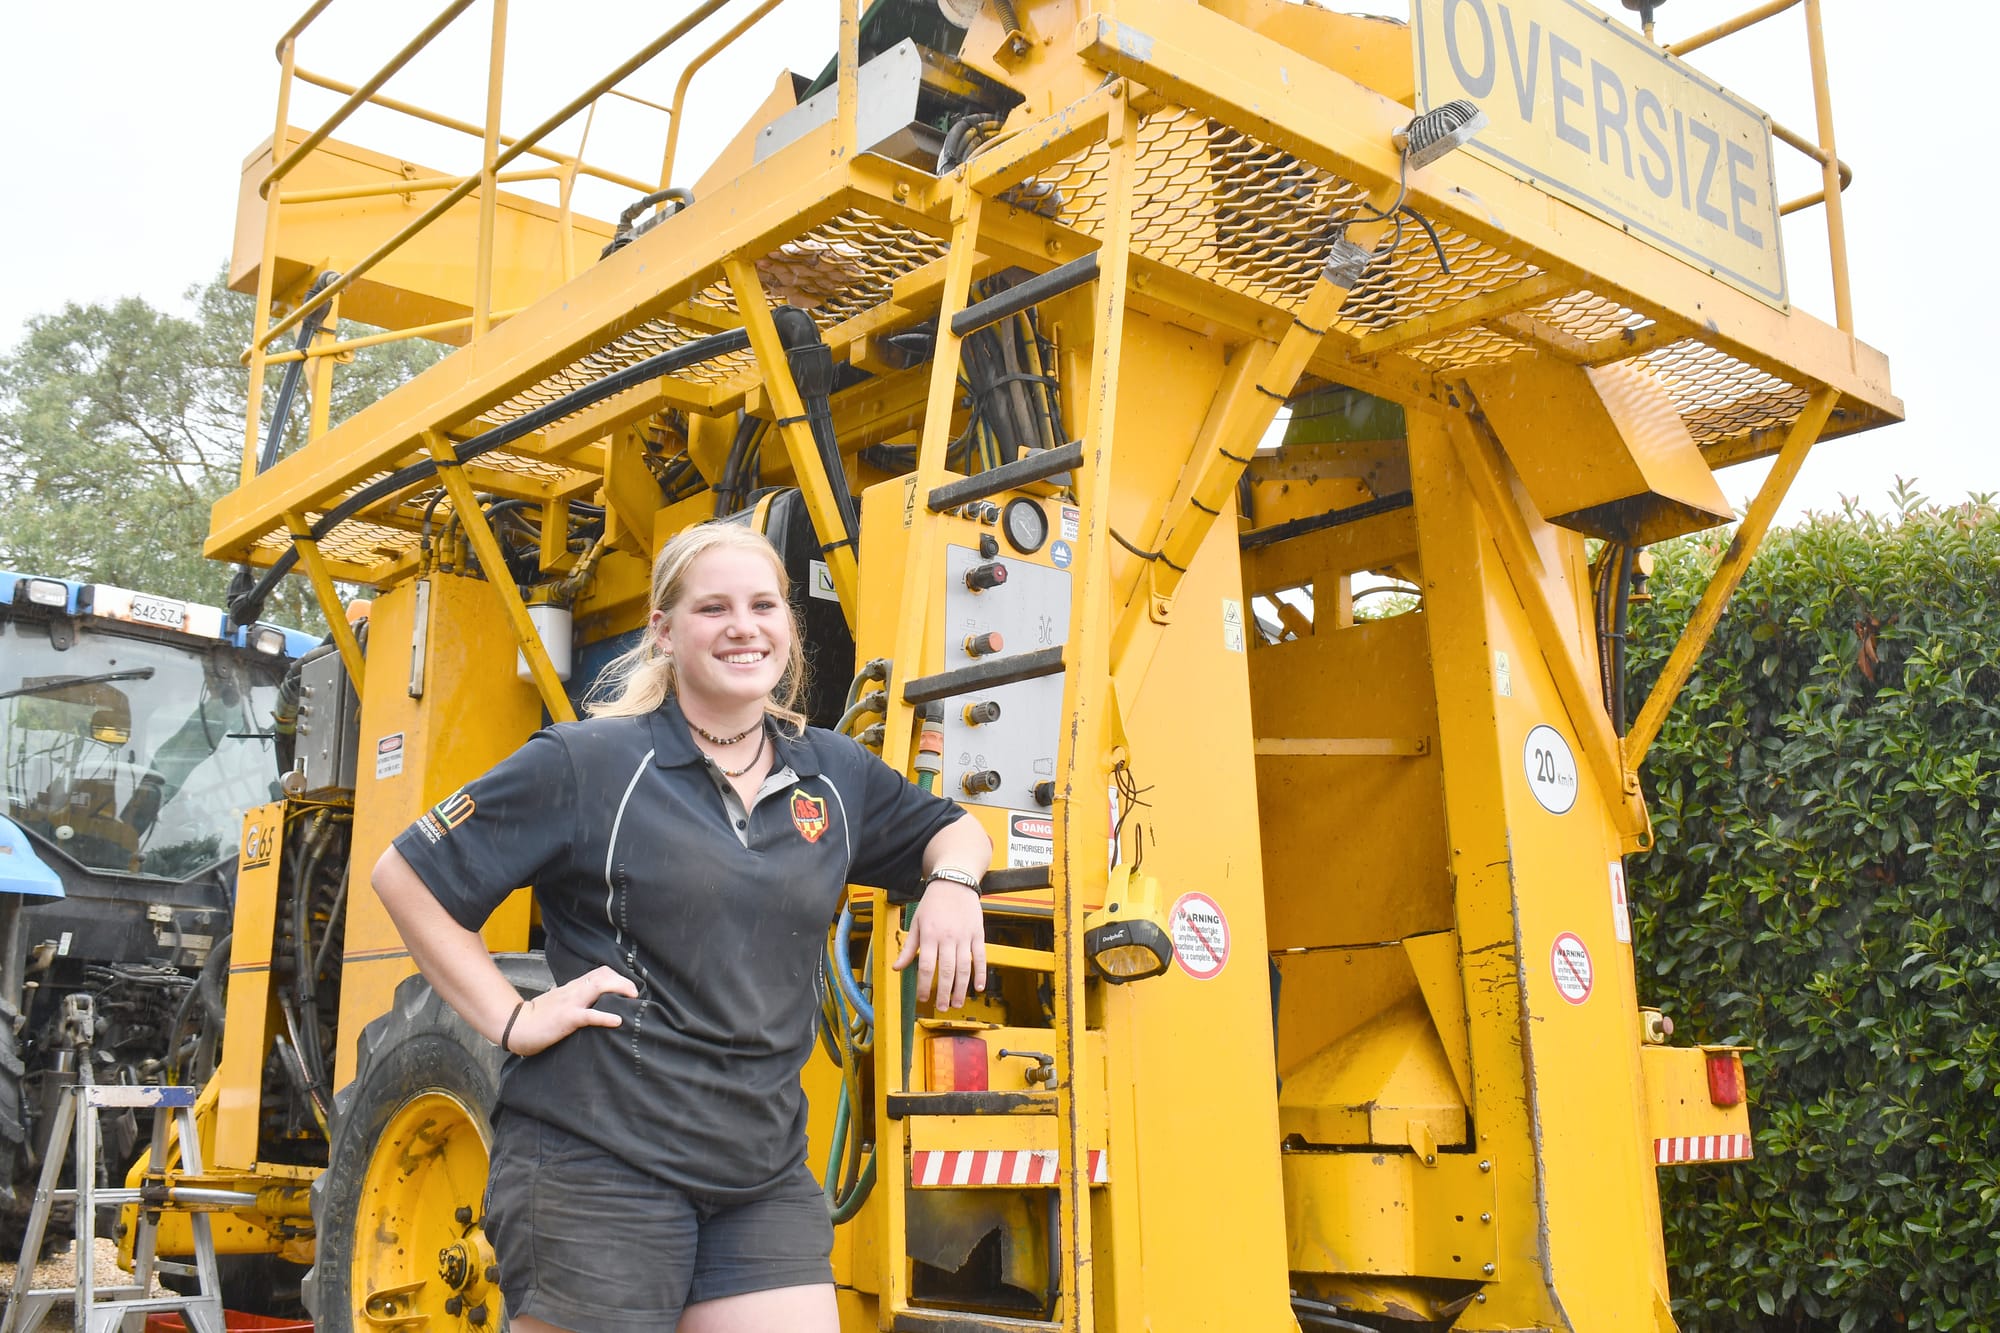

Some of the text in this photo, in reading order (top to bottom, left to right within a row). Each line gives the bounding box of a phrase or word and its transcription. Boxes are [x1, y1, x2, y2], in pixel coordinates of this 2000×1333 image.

[1443, 0, 1764, 249] OVERSIZE
[134, 603, 157, 620] S42
[1535, 748, 1555, 784] 20
[1010, 842, 1044, 854] AUTHORISED
[1177, 911, 1219, 924] WARNING
[1556, 949, 1585, 959] WARNING
